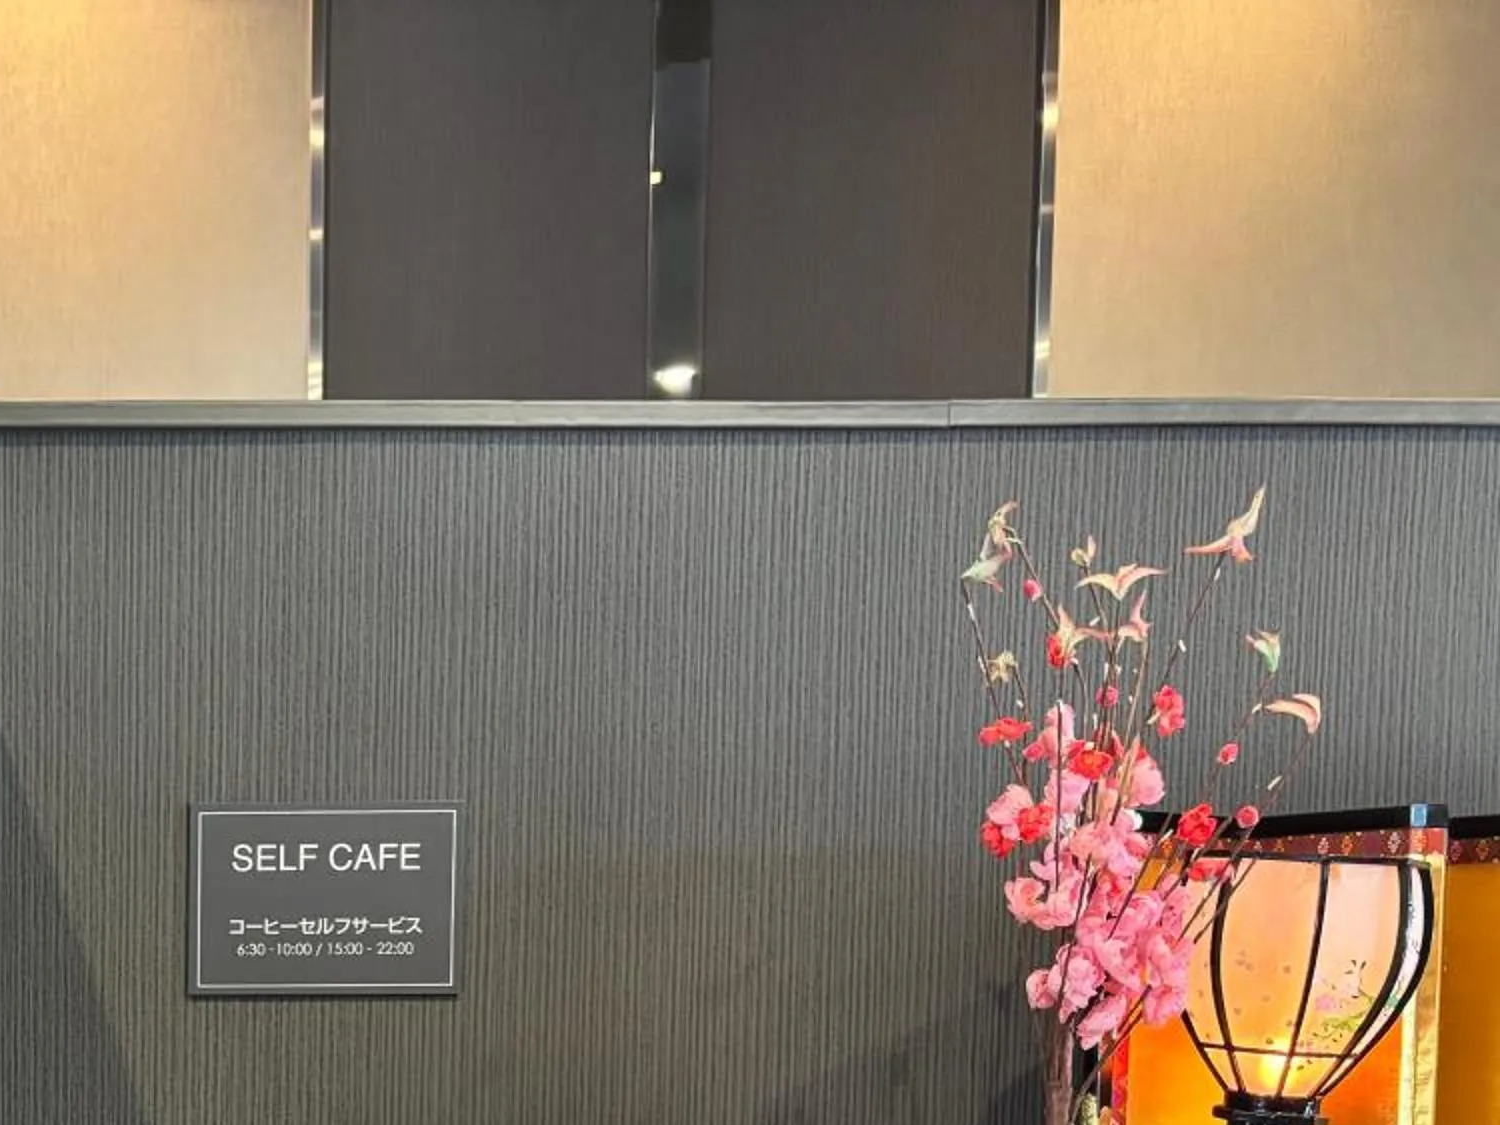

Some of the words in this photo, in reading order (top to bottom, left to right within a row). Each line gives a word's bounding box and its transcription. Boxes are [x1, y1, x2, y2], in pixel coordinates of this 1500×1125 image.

[231, 843, 319, 873] SELF
[328, 843, 421, 872] CAFE
[229, 917, 423, 935] コーヒーセルフサービス
[236, 944, 267, 957] 6:30
[276, 943, 312, 957] 10:00
[327, 942, 363, 956] 15:00
[376, 942, 415, 956] 22:00
